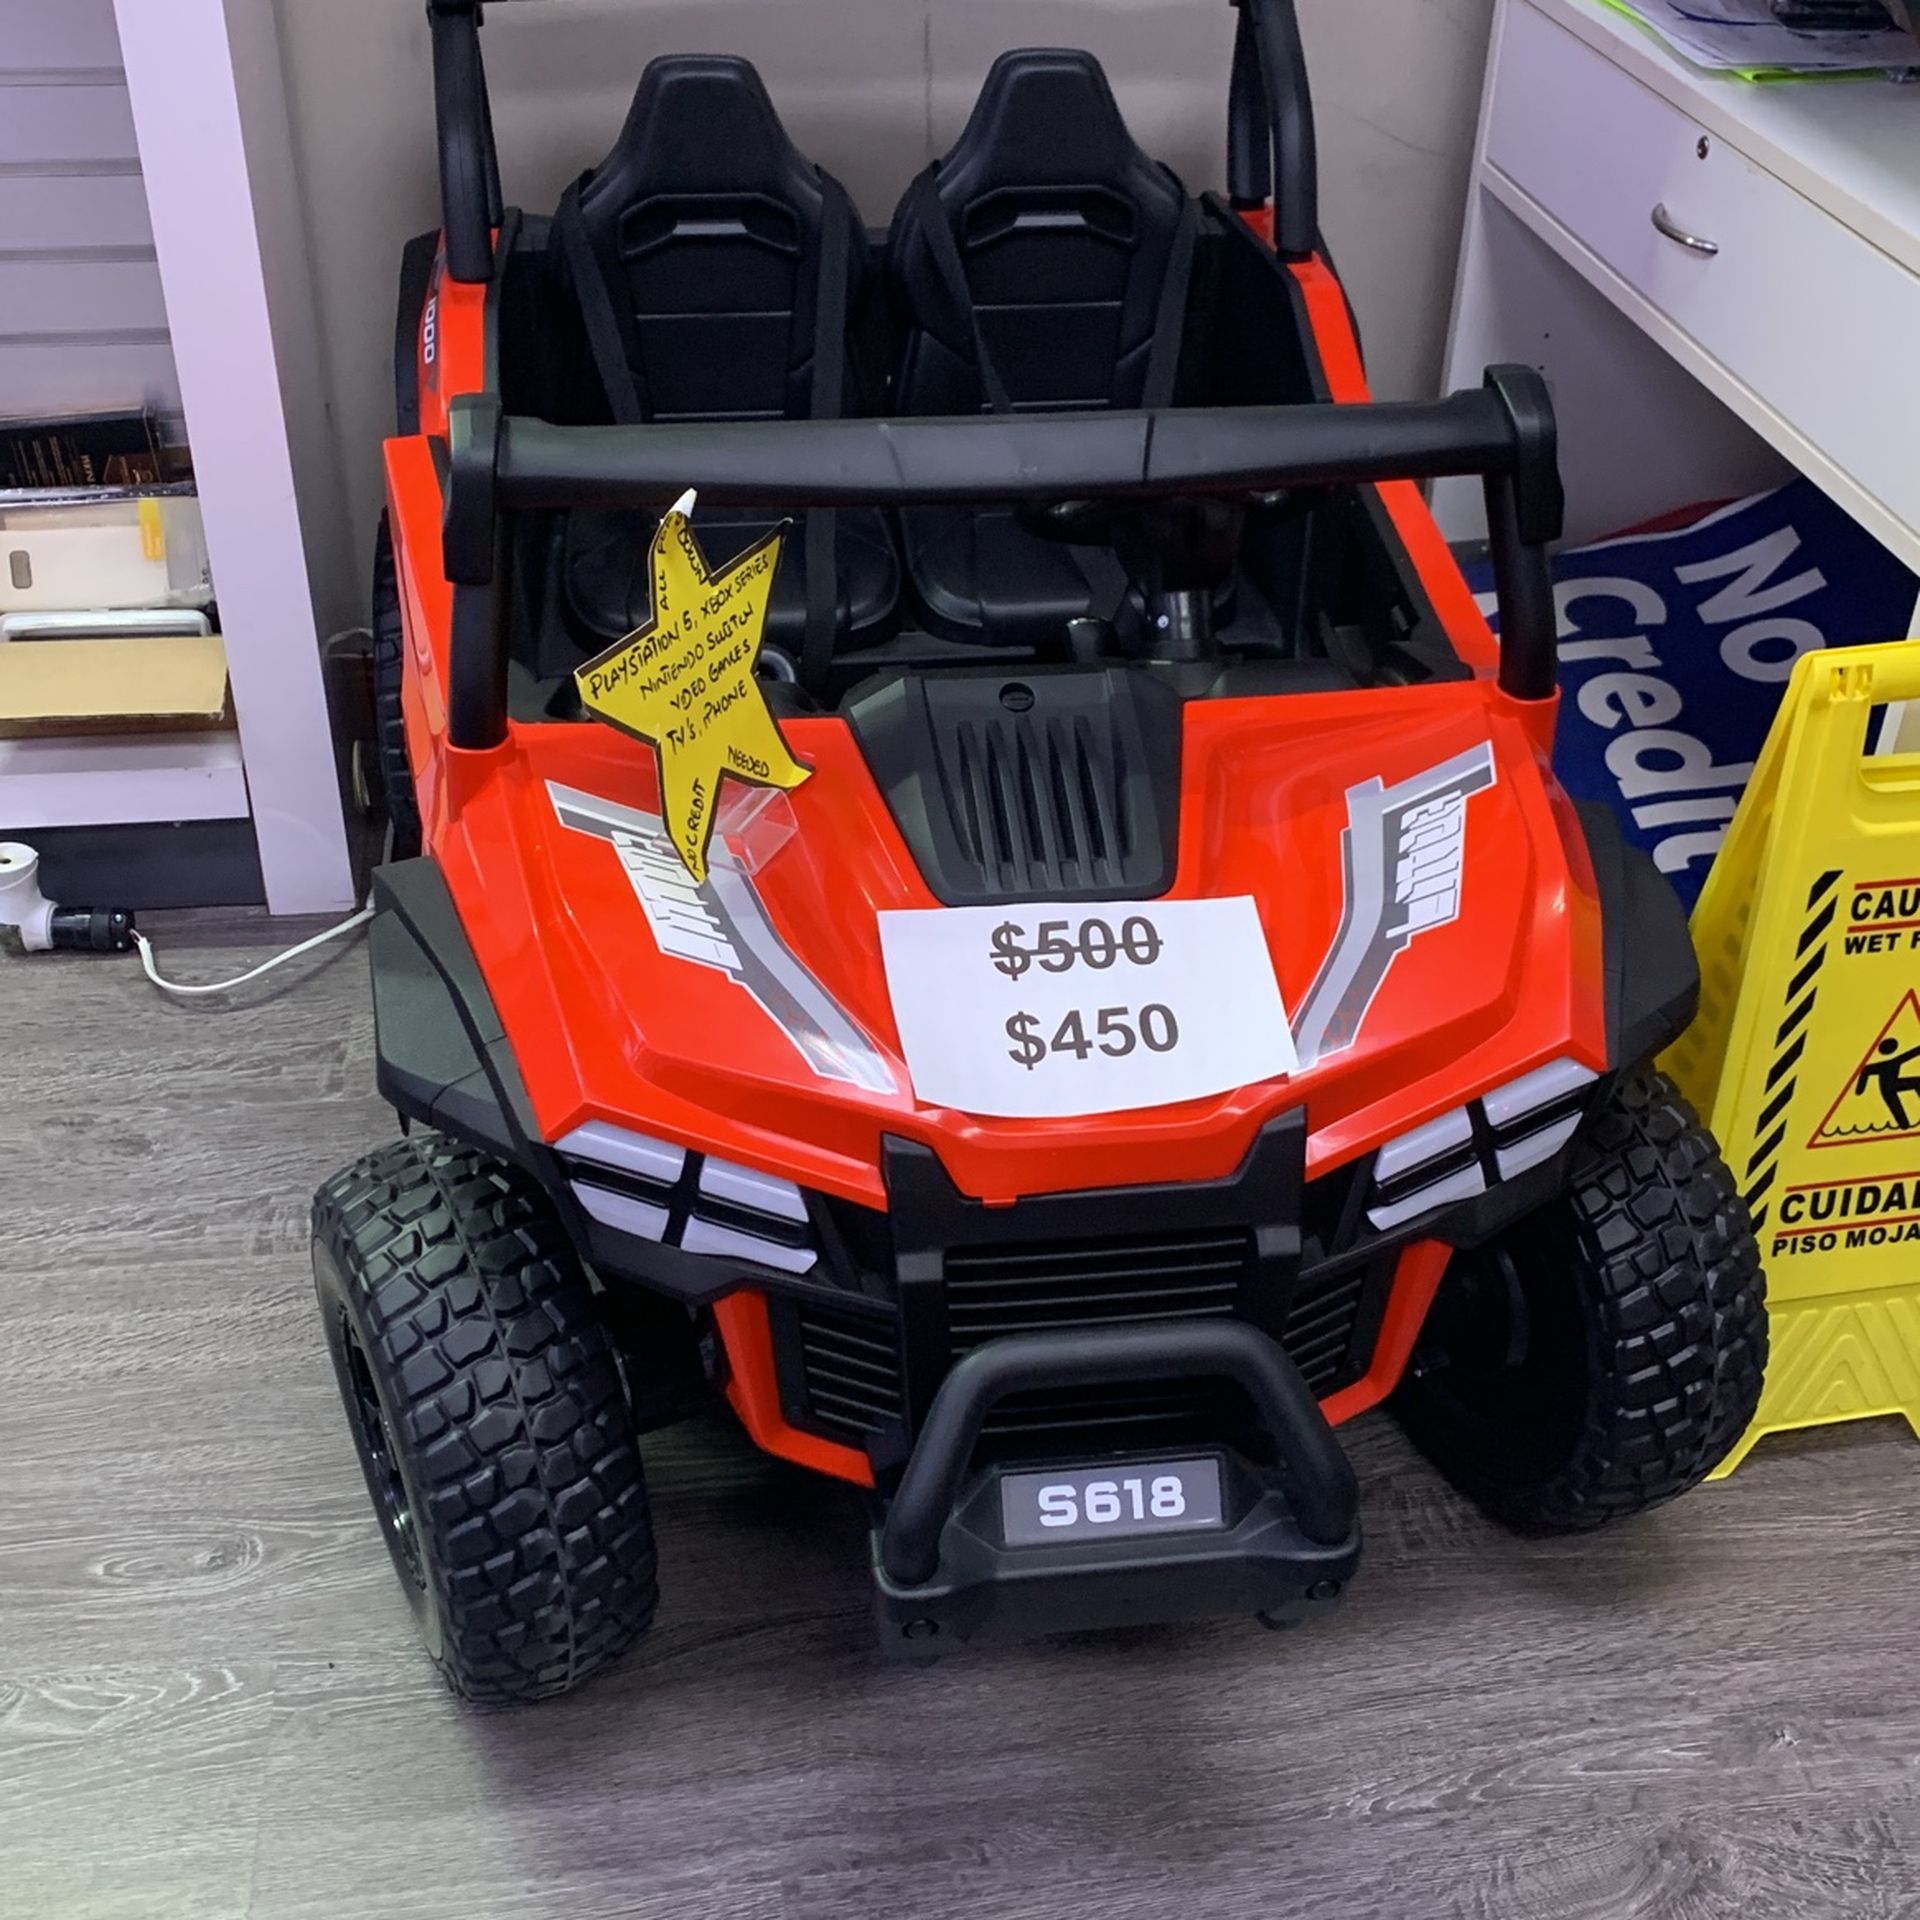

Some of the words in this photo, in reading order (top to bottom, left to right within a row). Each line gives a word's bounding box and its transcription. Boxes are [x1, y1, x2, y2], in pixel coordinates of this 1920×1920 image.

[589, 621, 680, 700] PLAYSTATION
[701, 584, 733, 619] XBOX
[734, 554, 769, 593] SERIES
[1674, 525, 1828, 683] No
[640, 643, 704, 700] NINTENDO
[670, 677, 706, 710] VIDEO
[708, 638, 751, 682] GAMES
[728, 744, 770, 778] NEEDED
[686, 777, 705, 846] CREDIT
[687, 849, 700, 871] NO
[1850, 887, 1920, 922] CAU
[990, 916, 1163, 981] $500
[1845, 932, 1902, 955] WET
[1005, 1003, 1179, 1070] $450
[1772, 1232, 1837, 1257] PISO
[1844, 1223, 1920, 1249] MOJA
[1038, 1476, 1186, 1527] S618
